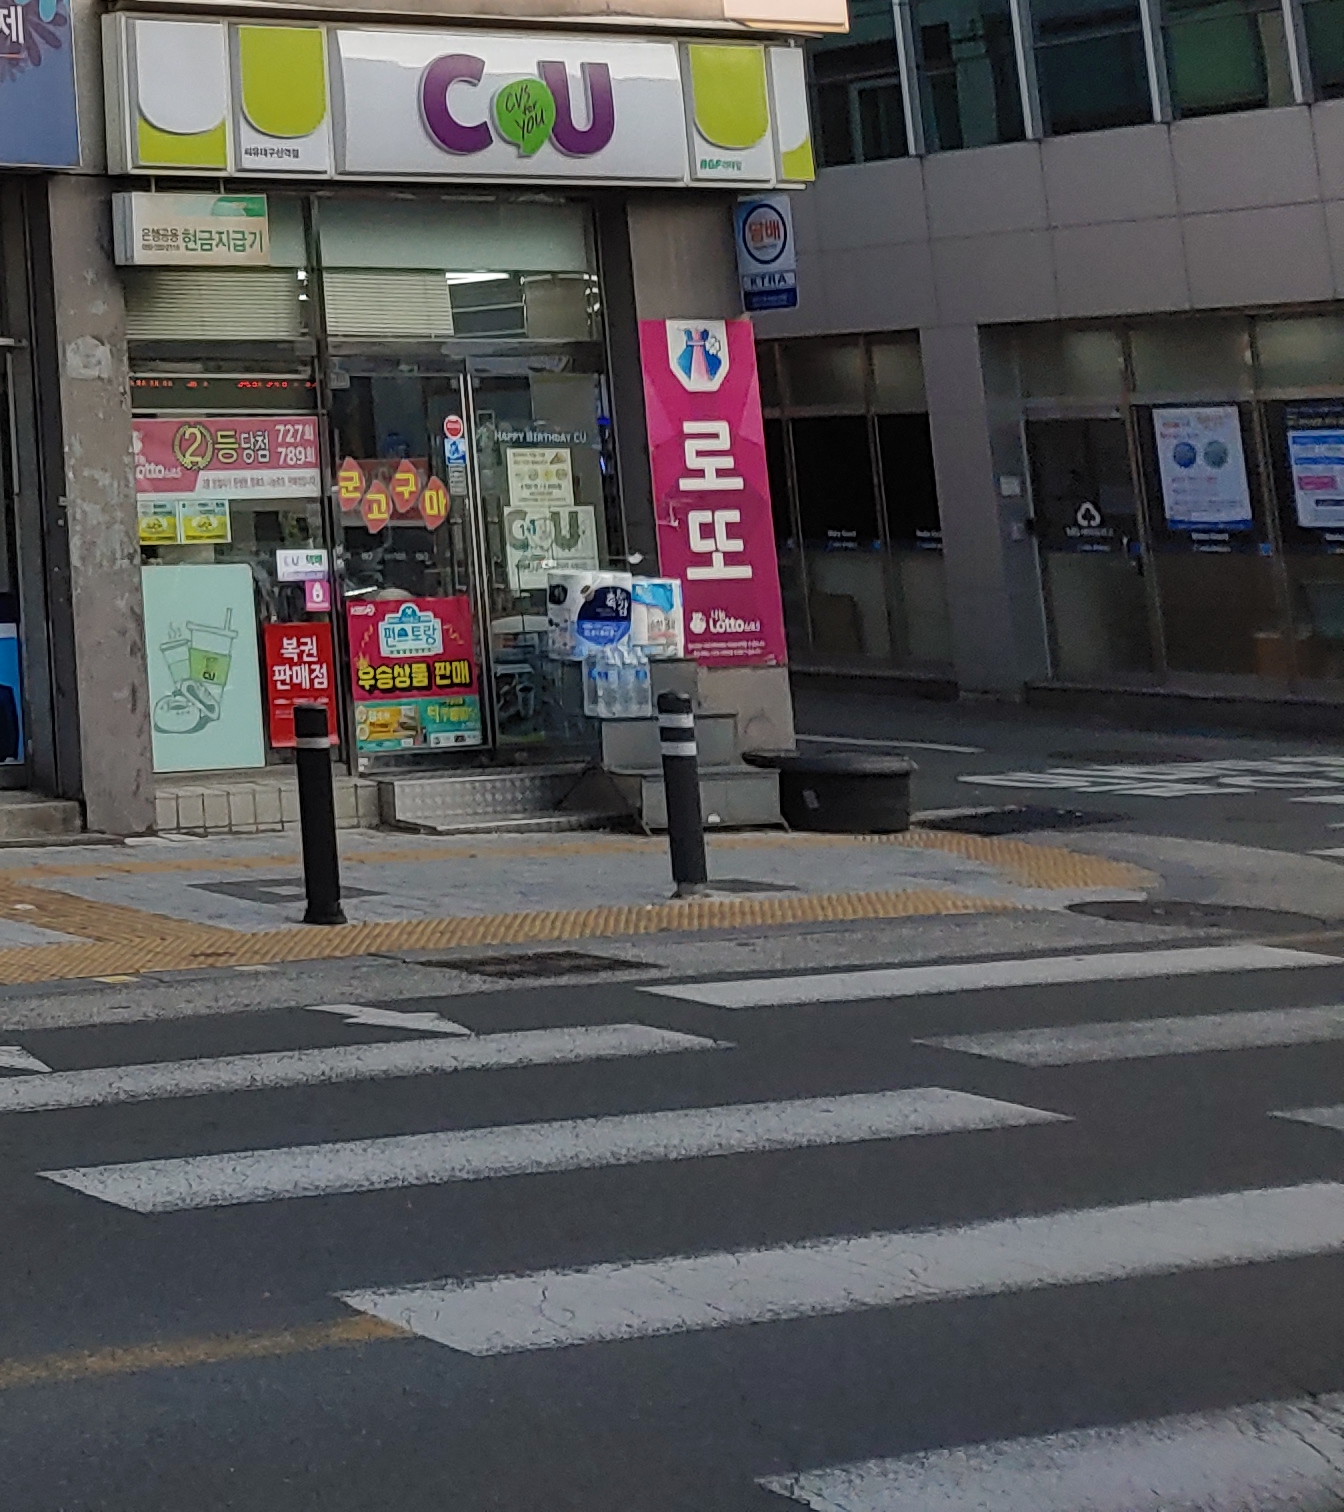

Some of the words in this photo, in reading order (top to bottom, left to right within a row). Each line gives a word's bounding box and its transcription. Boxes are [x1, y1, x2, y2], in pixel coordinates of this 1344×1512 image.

[419, 53, 615, 156] CU
[504, 84, 531, 114] CVS
[514, 108, 545, 142] YOU
[181, 227, 264, 254] 현금지급기
[240, 430, 270, 464] 당첨
[494, 431, 526, 443] HAPPY
[525, 431, 572, 443] BIRTHDAY
[573, 430, 587, 444] CU
[130, 463, 165, 480] otto
[678, 419, 753, 581] 로또
[708, 616, 745, 634] Lotto
[280, 635, 319, 663] 복권
[272, 663, 330, 690] 판매점
[357, 662, 429, 691] 우승상품
[433, 659, 471, 686] 판매
